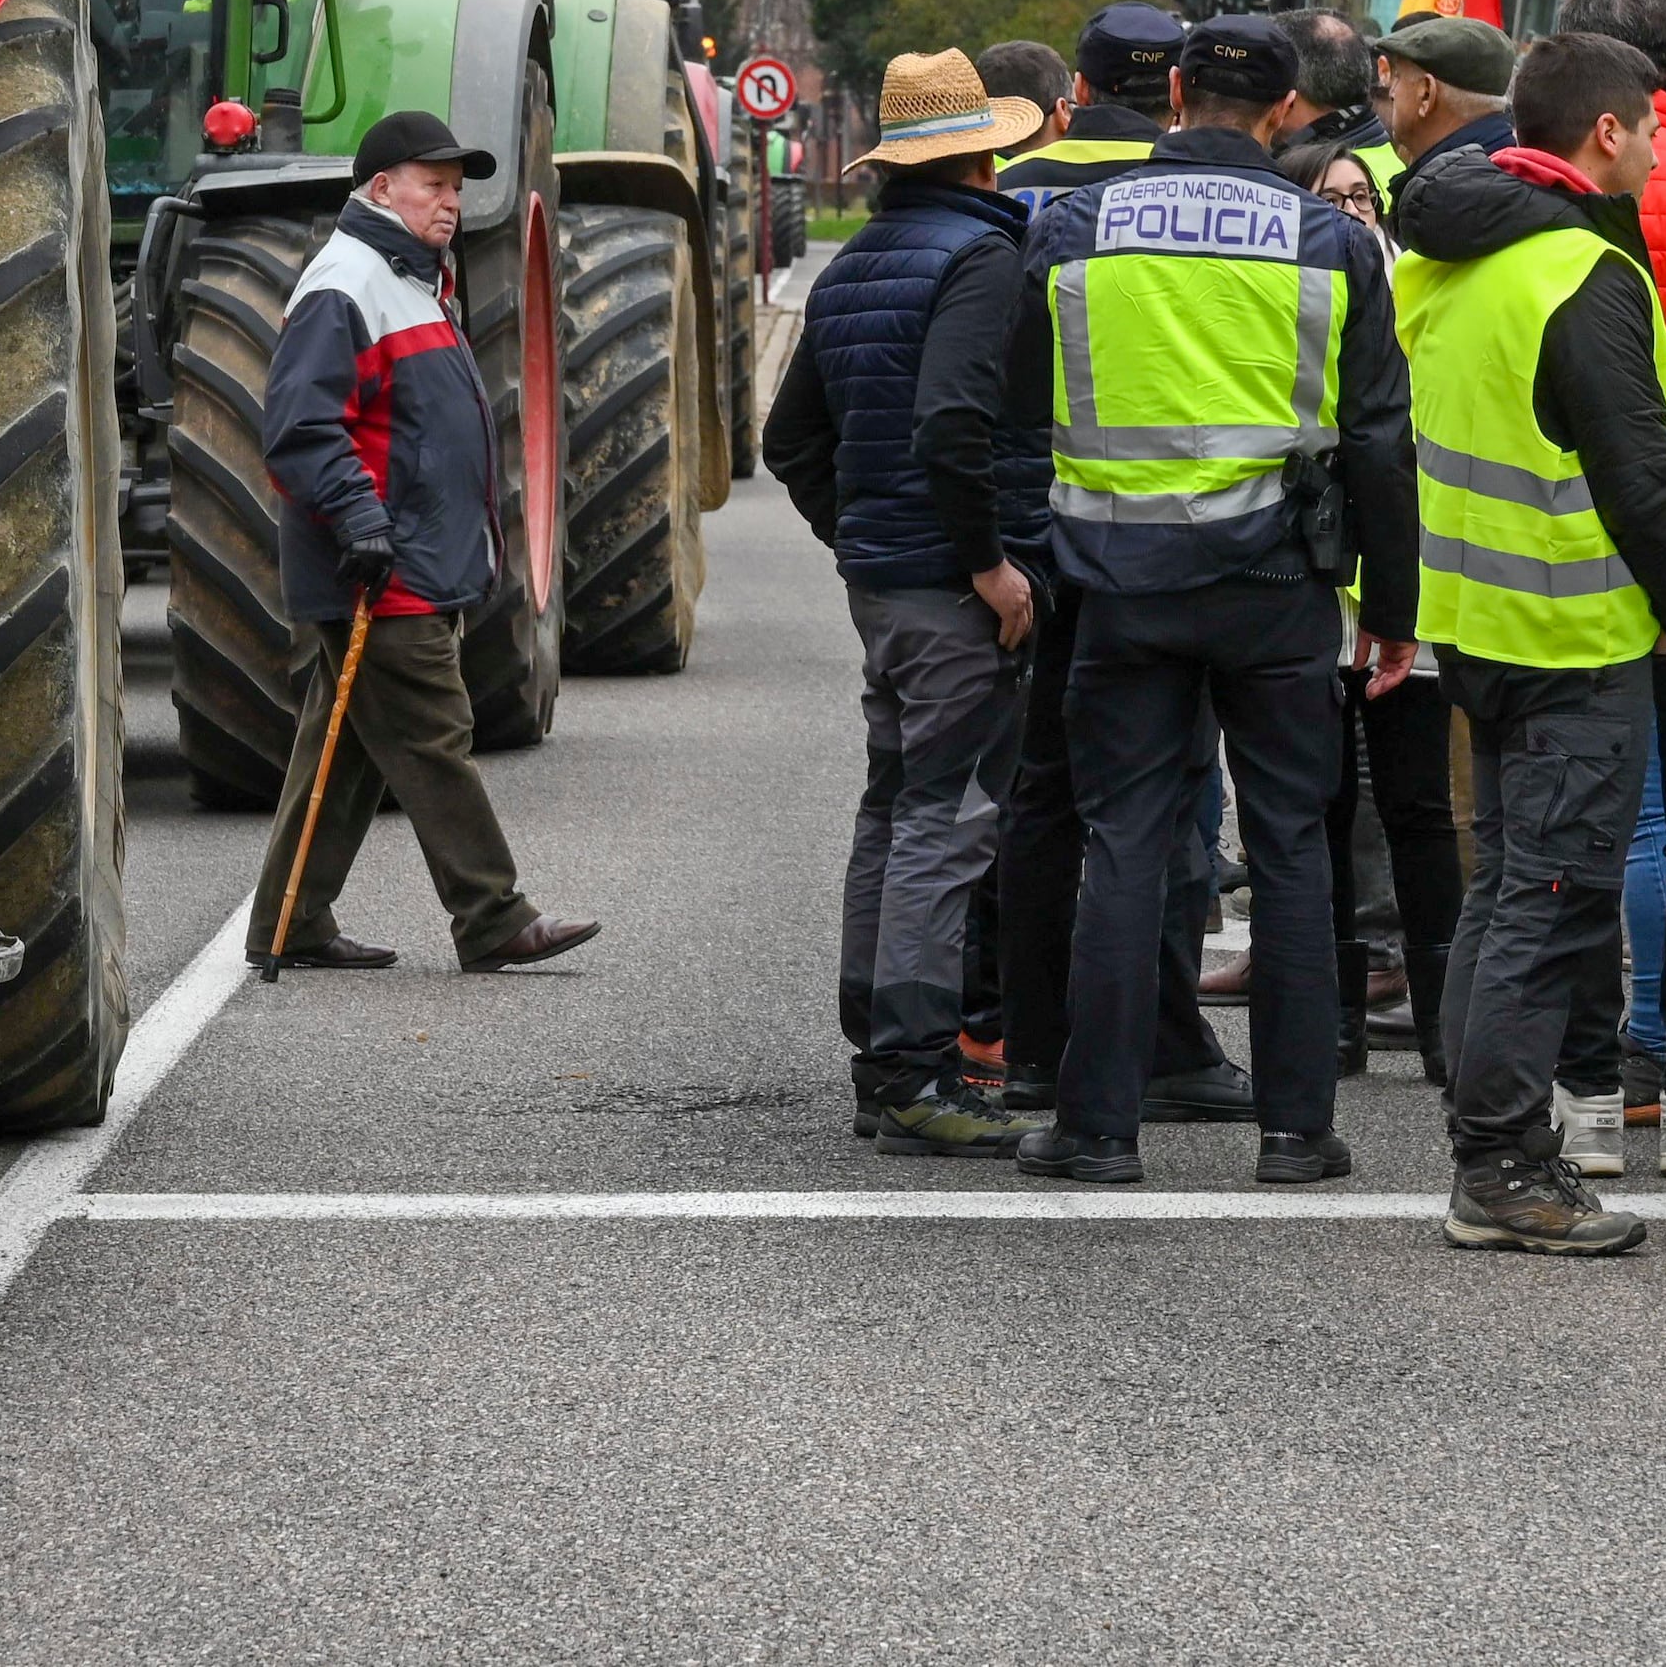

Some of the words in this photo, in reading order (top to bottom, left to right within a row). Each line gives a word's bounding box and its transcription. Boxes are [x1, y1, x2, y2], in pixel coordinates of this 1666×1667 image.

[1131, 50, 1165, 64] CNP
[1213, 44, 1248, 60] CNP
[1109, 180, 1177, 203] CUERPO
[1182, 181, 1266, 207] NACIONAL
[1270, 194, 1293, 212] DE
[1103, 203, 1289, 250] POLICIA
